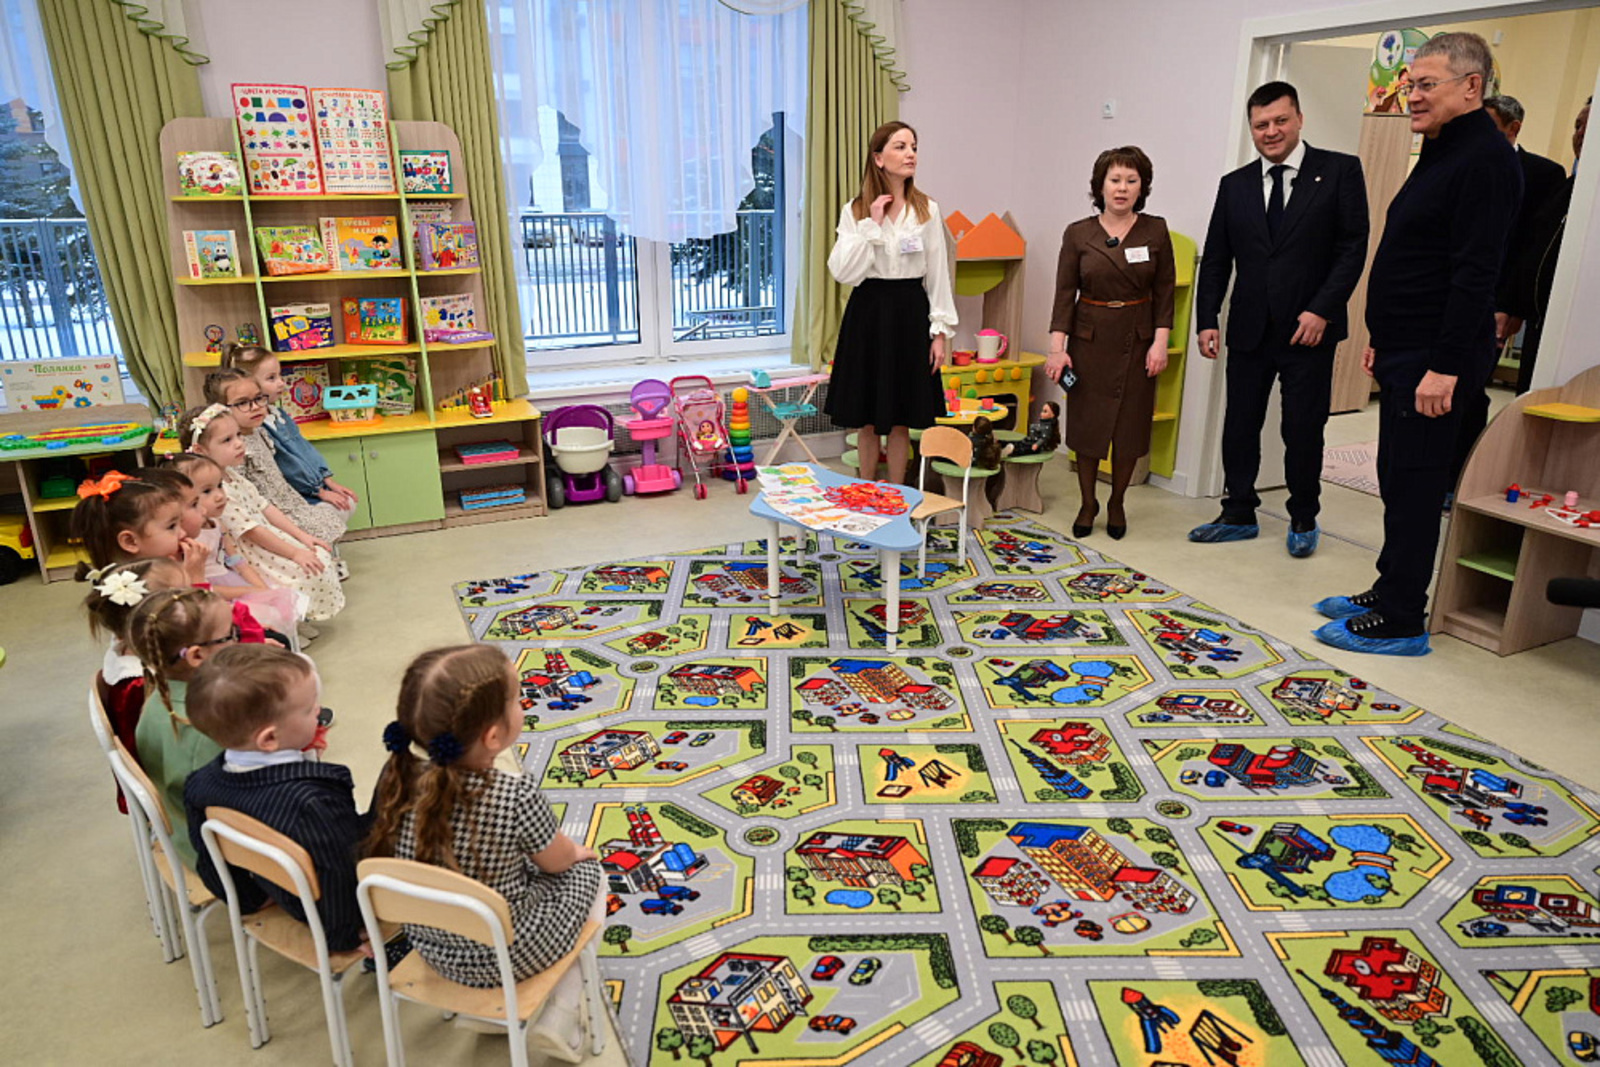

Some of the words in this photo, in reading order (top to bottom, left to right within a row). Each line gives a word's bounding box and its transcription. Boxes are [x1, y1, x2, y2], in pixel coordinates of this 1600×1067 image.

[318, 99, 324, 108] 1
[332, 98, 338, 107] 2
[346, 99, 352, 107] 3
[358, 99, 364, 107] 4
[372, 100, 379, 109] 5
[321, 119, 328, 127] 6
[335, 119, 340, 127] 7
[348, 119, 355, 128] 8
[362, 120, 368, 128] 9
[349, 140, 359, 148] 13
[375, 141, 385, 149] 15
[325, 161, 335, 169] 16
[339, 161, 348, 169] 17
[352, 161, 361, 169] 18
